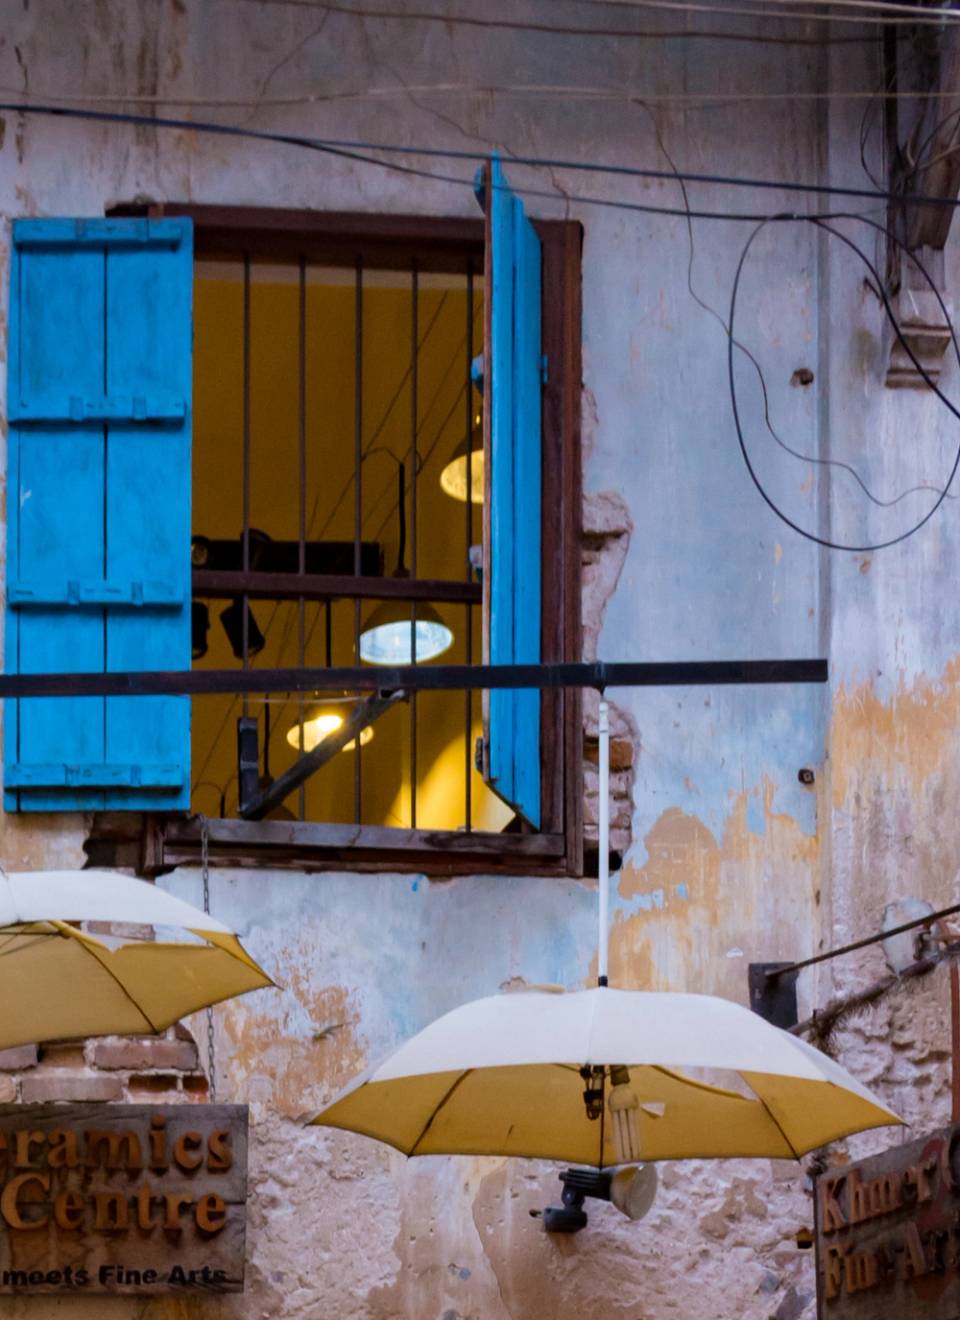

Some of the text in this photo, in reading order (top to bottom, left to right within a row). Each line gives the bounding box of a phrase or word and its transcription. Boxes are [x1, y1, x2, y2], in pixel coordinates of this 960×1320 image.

[0, 1172, 227, 1233] Centre
[822, 1165, 933, 1233] Khmer
[2, 1267, 89, 1286] meets
[99, 1265, 158, 1285] Fine
[168, 1265, 227, 1284] Arts
